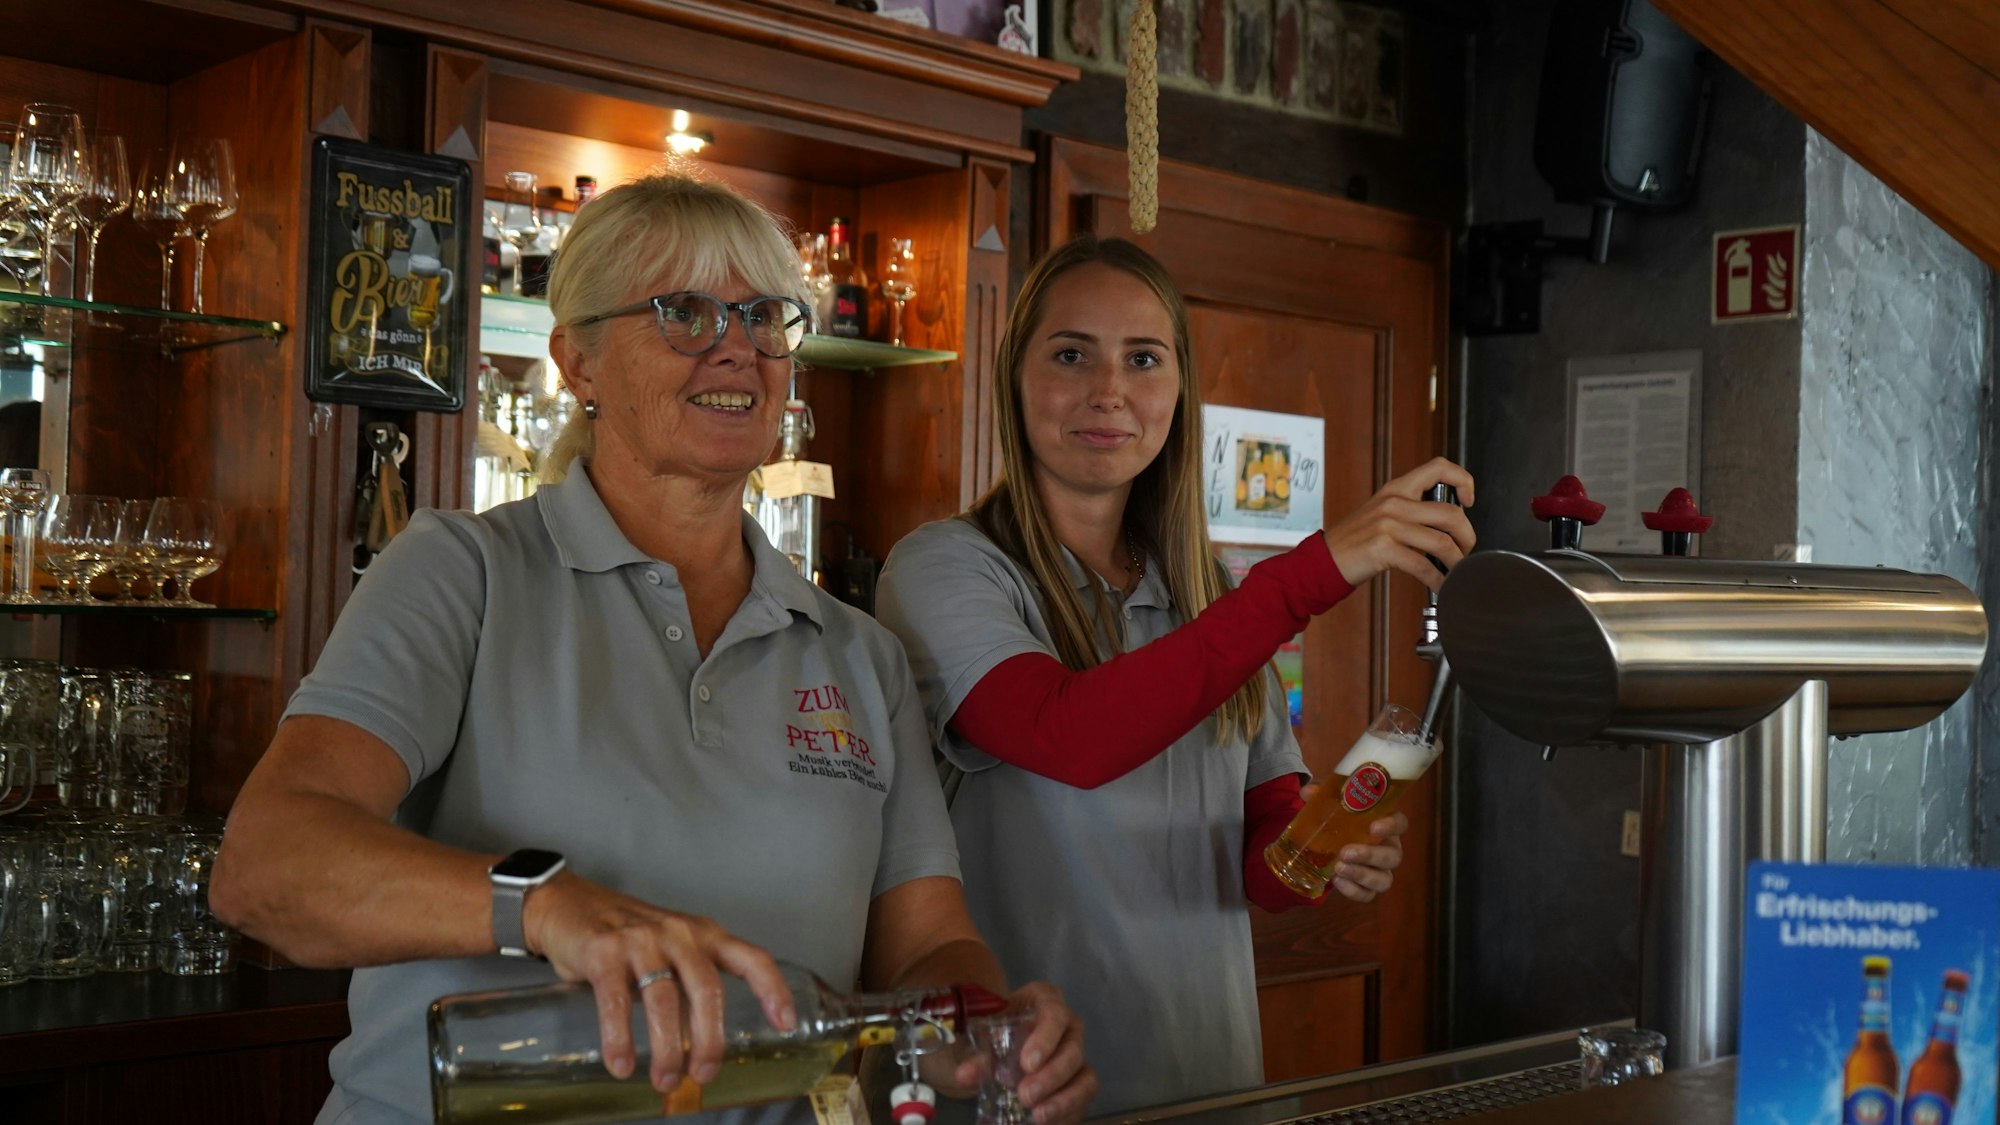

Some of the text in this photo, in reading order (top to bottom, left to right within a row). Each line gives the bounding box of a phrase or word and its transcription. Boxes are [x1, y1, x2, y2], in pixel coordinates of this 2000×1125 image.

[336, 171, 453, 224] Fussball
[393, 228, 409, 249] &
[330, 250, 425, 334] Bier
[389, 328, 417, 344] gönn
[358, 354, 389, 371] ICH
[793, 685, 851, 716] ZUM
[785, 723, 876, 767] PETER
[788, 760, 810, 774] Ein
[811, 764, 848, 779] kühles
[798, 752, 833, 767] Musik
[1761, 873, 1789, 892] Für
[1756, 892, 1939, 928] Erfrischungs-
[1779, 920, 1921, 951] Liebhaber.
